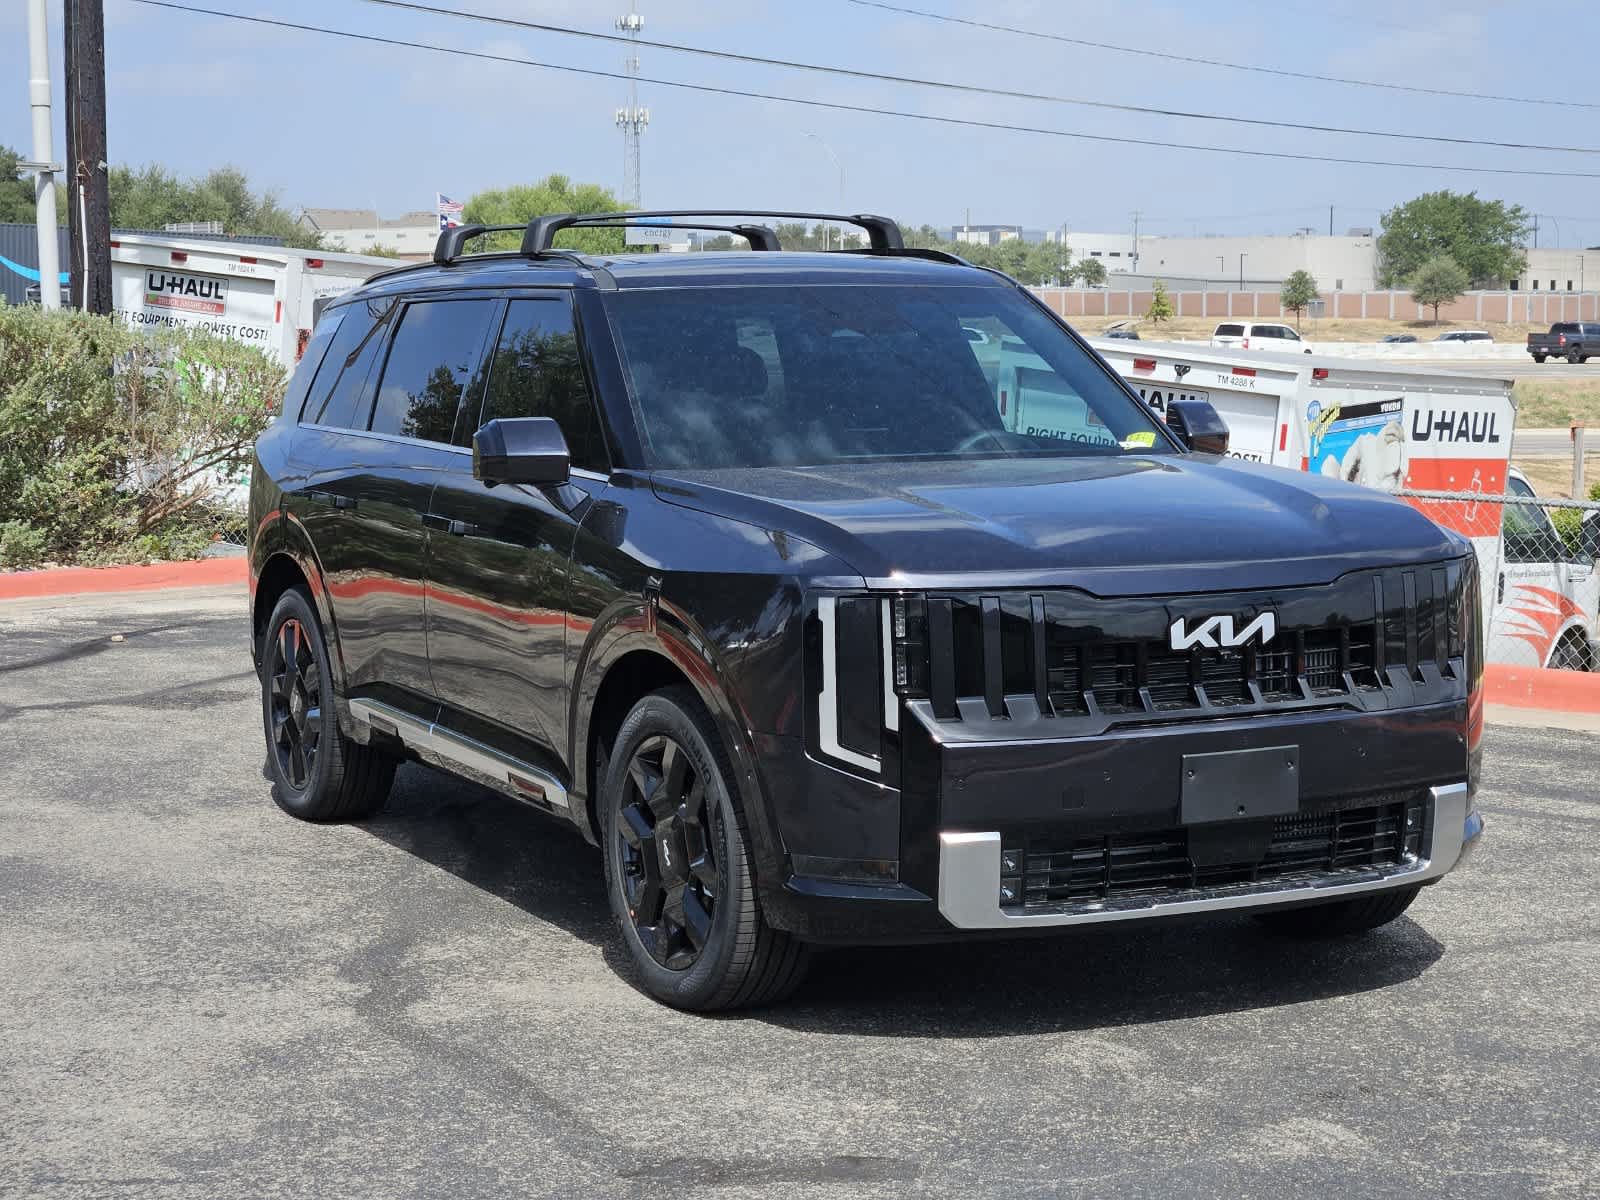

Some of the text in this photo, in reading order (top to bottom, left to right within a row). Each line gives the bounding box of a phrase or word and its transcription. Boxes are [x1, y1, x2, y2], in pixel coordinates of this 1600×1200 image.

[149, 273, 224, 300] U-HAUL
[239, 327, 268, 341] COST!
[1217, 374, 1229, 385] TM
[1249, 378, 1256, 389] K
[1411, 409, 1500, 443] U-HAUL
[1170, 612, 1275, 650] KIA
